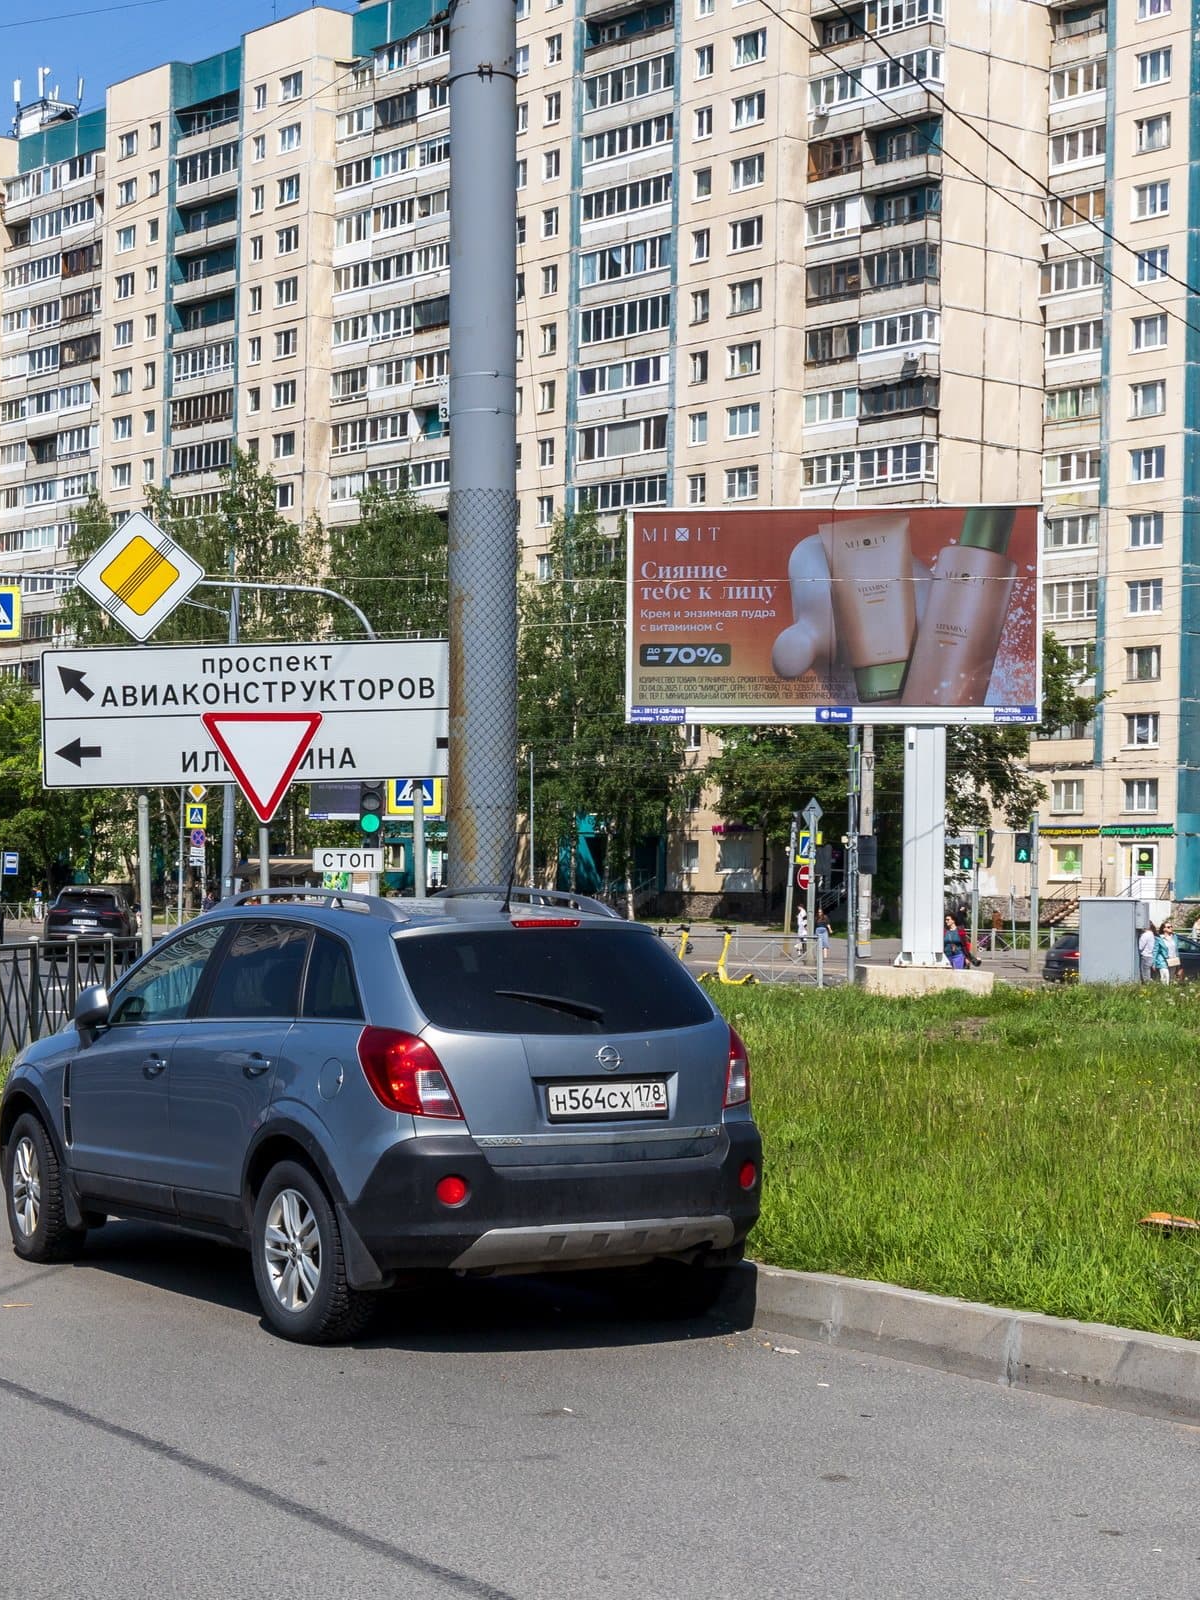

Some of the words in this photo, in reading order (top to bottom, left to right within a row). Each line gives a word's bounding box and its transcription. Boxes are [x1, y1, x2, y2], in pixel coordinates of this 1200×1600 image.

[641, 561, 728, 579] Сияние
[640, 582, 691, 600] тебе
[699, 586, 712, 600] к
[720, 586, 776, 604] лицу
[640, 609, 670, 619] Крем
[673, 610, 681, 618] и
[684, 610, 738, 618] энзимная
[741, 609, 776, 619] пудра
[202, 654, 333, 679] проспект
[101, 677, 436, 707] АВИАКОНСТРУКТОРОВ
[181, 747, 357, 773] ИЛИНА
[322, 853, 375, 868] СТОП
[634, 1084, 661, 1102] 178
